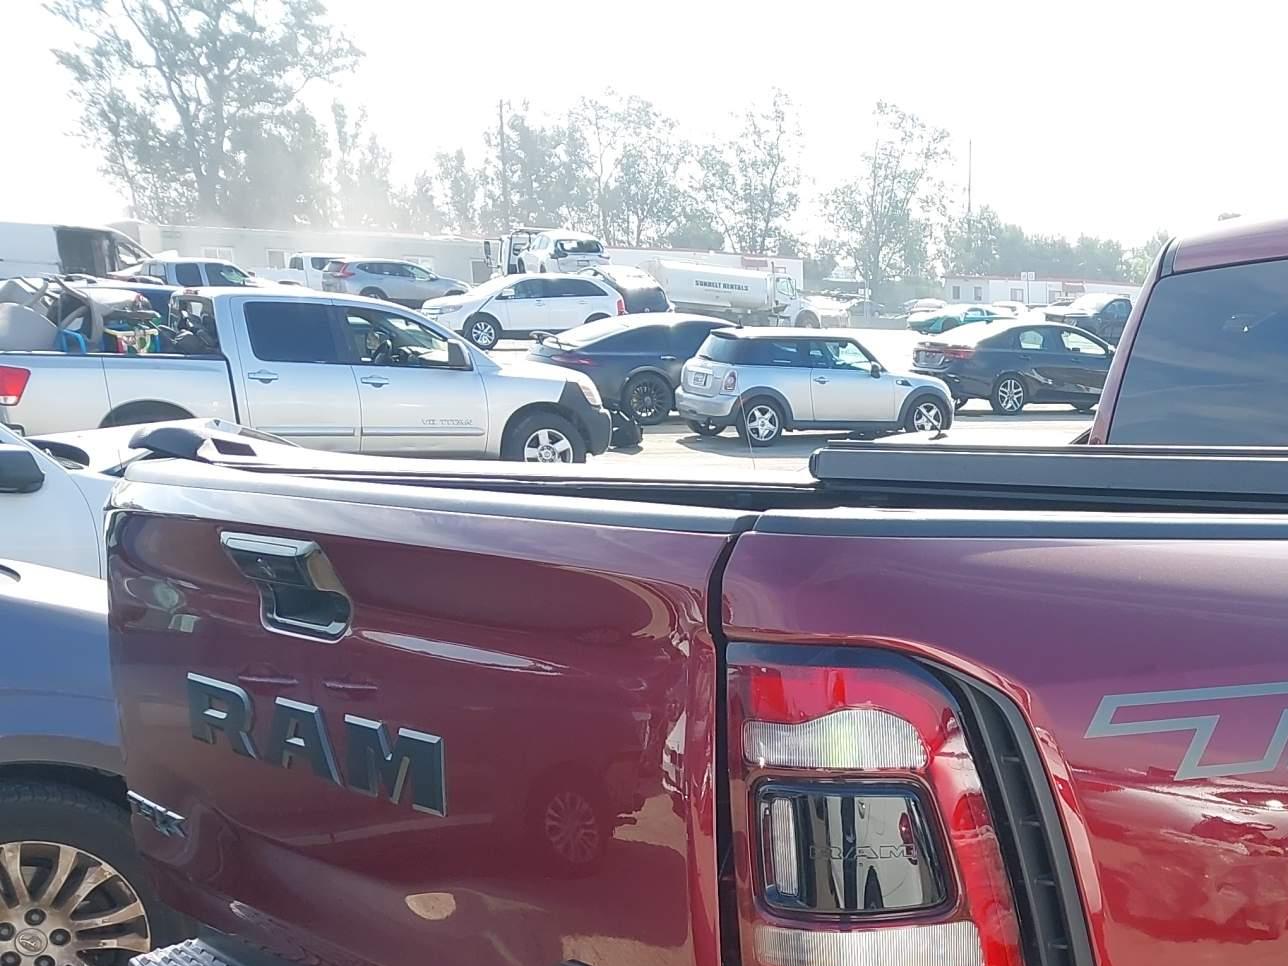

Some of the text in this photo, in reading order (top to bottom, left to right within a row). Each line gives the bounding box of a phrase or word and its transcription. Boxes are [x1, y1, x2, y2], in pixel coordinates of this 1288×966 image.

[695, 280, 721, 288] SUNBELT
[722, 283, 749, 291] RENTALS
[186, 672, 448, 817] RAM
[809, 844, 918, 860] RAM
